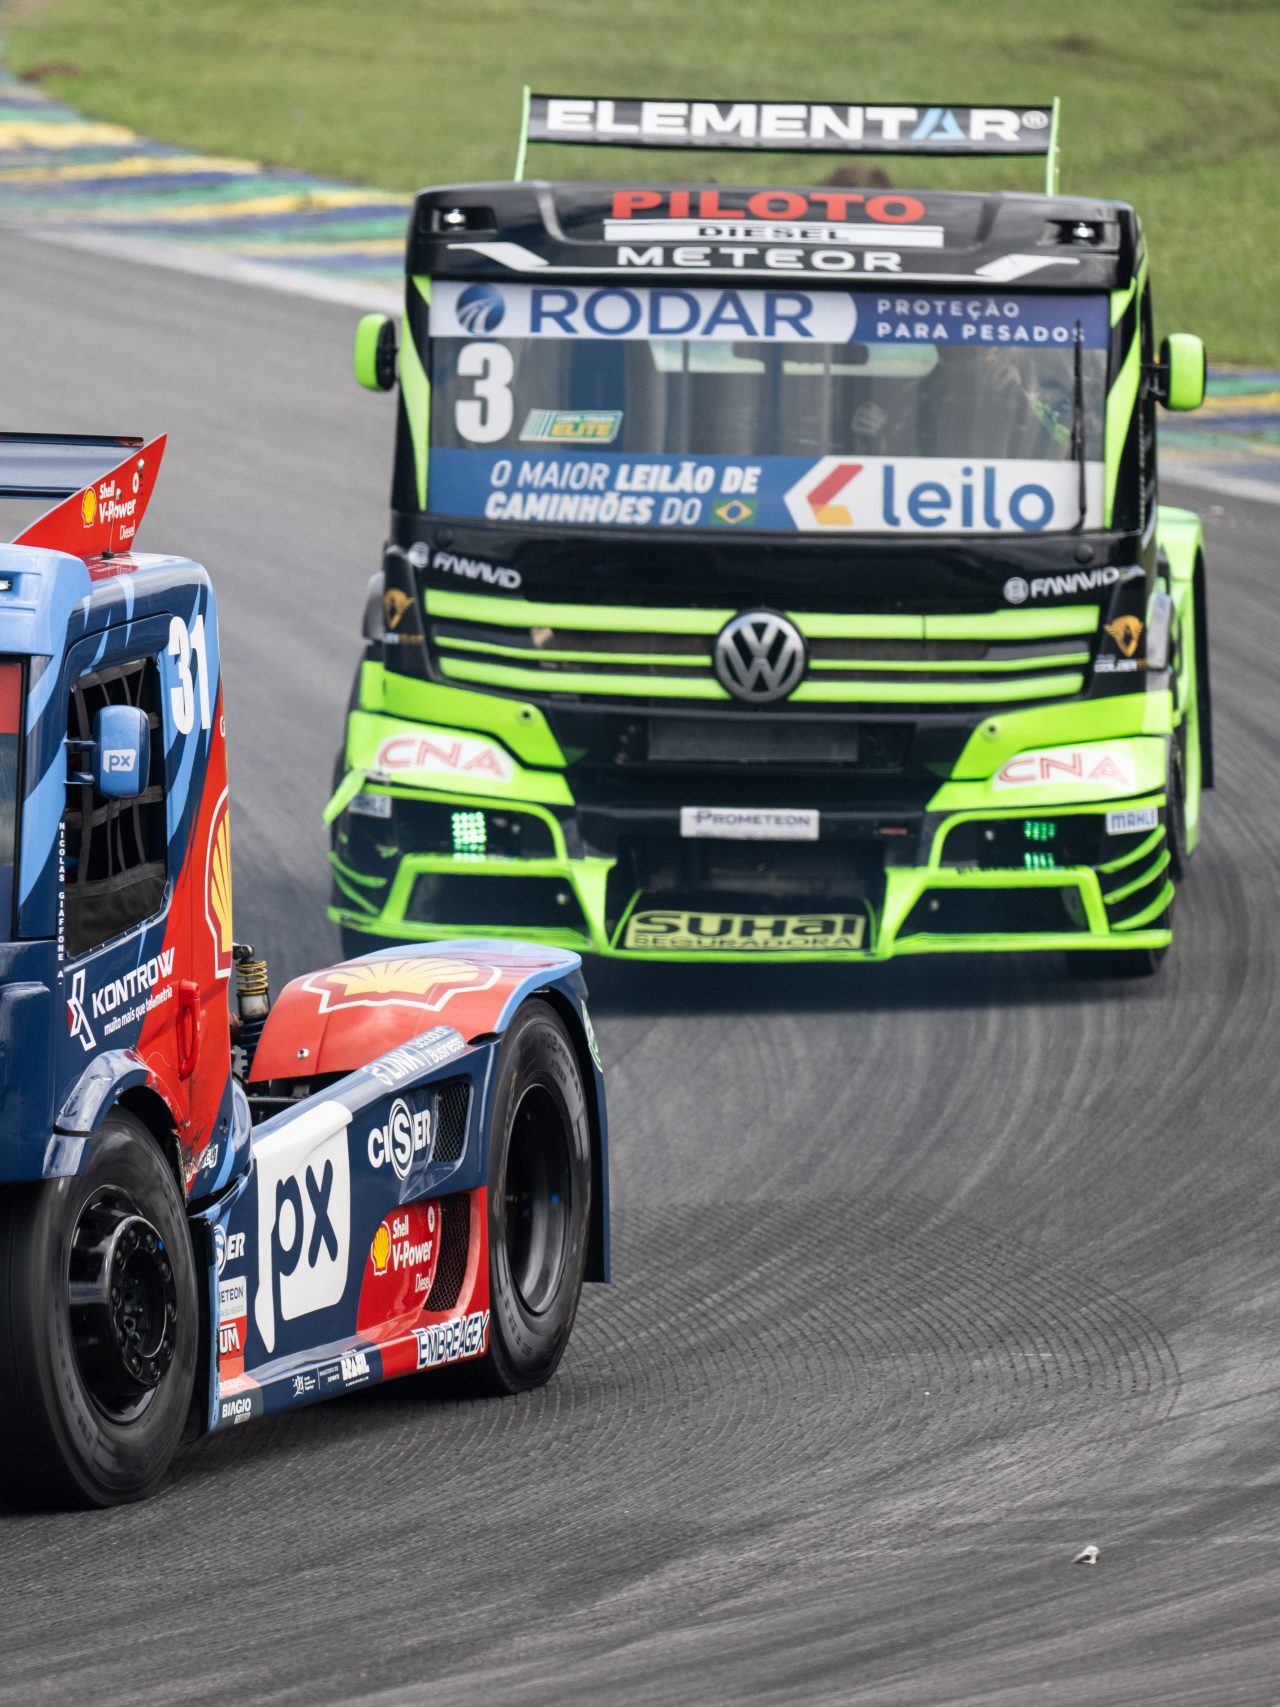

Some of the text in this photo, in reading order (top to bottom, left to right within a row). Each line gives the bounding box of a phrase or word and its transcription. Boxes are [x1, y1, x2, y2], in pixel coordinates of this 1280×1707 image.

[611, 190, 926, 224] PILOTO
[697, 225, 850, 242] DIESEL
[617, 246, 903, 273] METEOR
[529, 287, 815, 338] RODAR
[877, 322, 1086, 343] PARA PESADOS
[454, 341, 515, 444] 3
[99, 480, 116, 500] Shell
[490, 460, 762, 495] O MAIOR LEILÃO DE
[99, 498, 137, 524] V-Power
[484, 490, 703, 526] CAMINHÕES DO
[882, 464, 1055, 531] leilo
[119, 519, 136, 541] Diesel
[432, 551, 522, 590] FANAVID
[1030, 566, 1120, 599] FANAVID
[168, 614, 212, 735] 31
[107, 753, 133, 773] px
[378, 736, 507, 778] CNA
[998, 752, 1132, 787] CNA
[691, 810, 811, 827] PROMETEON
[58, 822, 66, 882] NICOLAS
[57, 891, 66, 961] GIAFFONE
[633, 936, 853, 949] SEGURADORA
[91, 946, 175, 1019] KONTROW
[104, 1016, 122, 1036] muito
[121, 1006, 136, 1027] mais
[135, 1003, 146, 1021] que
[367, 1106, 432, 1171] CISER
[271, 1159, 338, 1308] px
[392, 1213, 410, 1240] Shell
[392, 1239, 433, 1272] V-Power
[219, 1285, 245, 1304] ETEON
[414, 1267, 432, 1293] Diesel
[219, 1323, 241, 1355] UM
[410, 1308, 491, 1370] EMBREAGEX
[221, 1397, 252, 1419] BIAGIO
